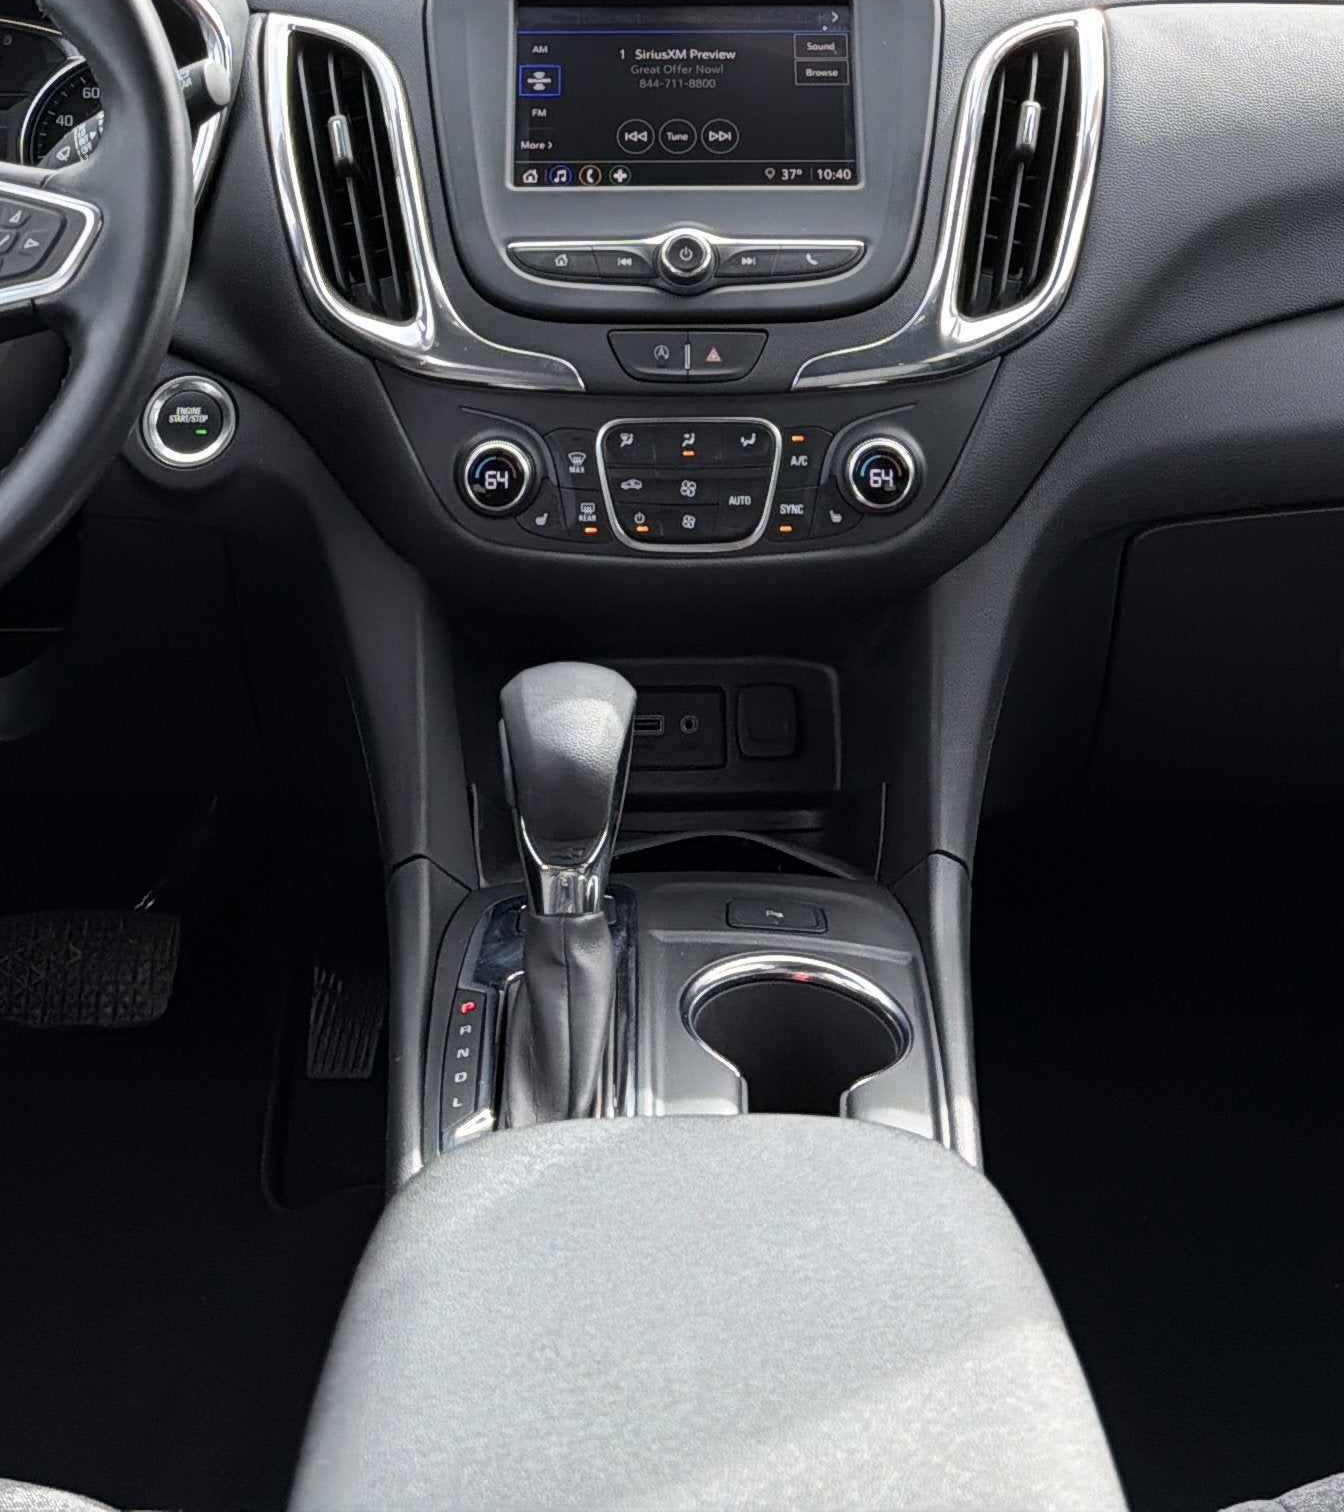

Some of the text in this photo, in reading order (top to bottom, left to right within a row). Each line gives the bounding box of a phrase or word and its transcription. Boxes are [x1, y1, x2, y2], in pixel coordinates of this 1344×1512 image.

[531, 44, 549, 55] AM
[806, 41, 836, 52] Sound
[619, 48, 737, 61] 1 SiriusXM Preview
[630, 64, 661, 75] Great
[663, 64, 692, 75] Offer
[805, 67, 839, 78] Browse
[639, 78, 717, 90] 844-711-8800
[82, 87, 101, 100] 60
[531, 108, 547, 118] FM
[55, 114, 74, 127] 40
[666, 131, 689, 142] Tune
[520, 140, 545, 151] More
[816, 168, 852, 181] 10:40
[790, 455, 808, 467] A/C
[568, 465, 587, 474] MAX
[484, 471, 509, 490] 64
[869, 468, 895, 488] 64
[728, 495, 752, 506] AUTO
[779, 503, 805, 515] SYNC
[460, 1000, 476, 1014] P
[456, 1047, 470, 1059] N
[454, 1071, 468, 1083] D
[452, 1097, 464, 1108] L
